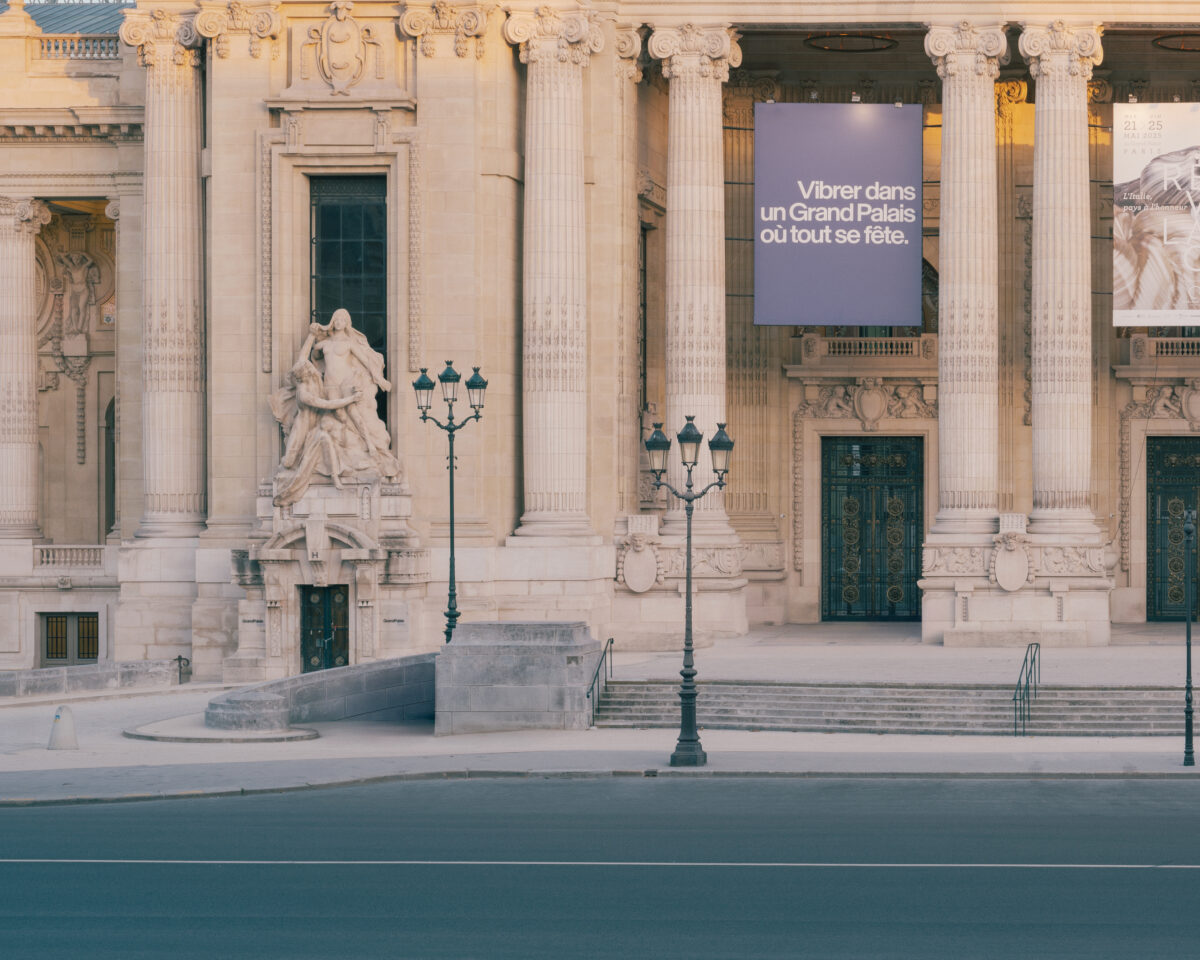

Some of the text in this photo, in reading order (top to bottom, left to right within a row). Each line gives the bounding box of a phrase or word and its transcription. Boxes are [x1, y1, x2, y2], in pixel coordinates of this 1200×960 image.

[1123, 120, 1163, 131] 21 25
[797, 181, 916, 201] Vibrer dans
[760, 202, 916, 223] un Grand Palais
[1123, 205, 1142, 213] pays
[760, 224, 909, 245] où tout se fête.
[311, 551, 319, 559] H
